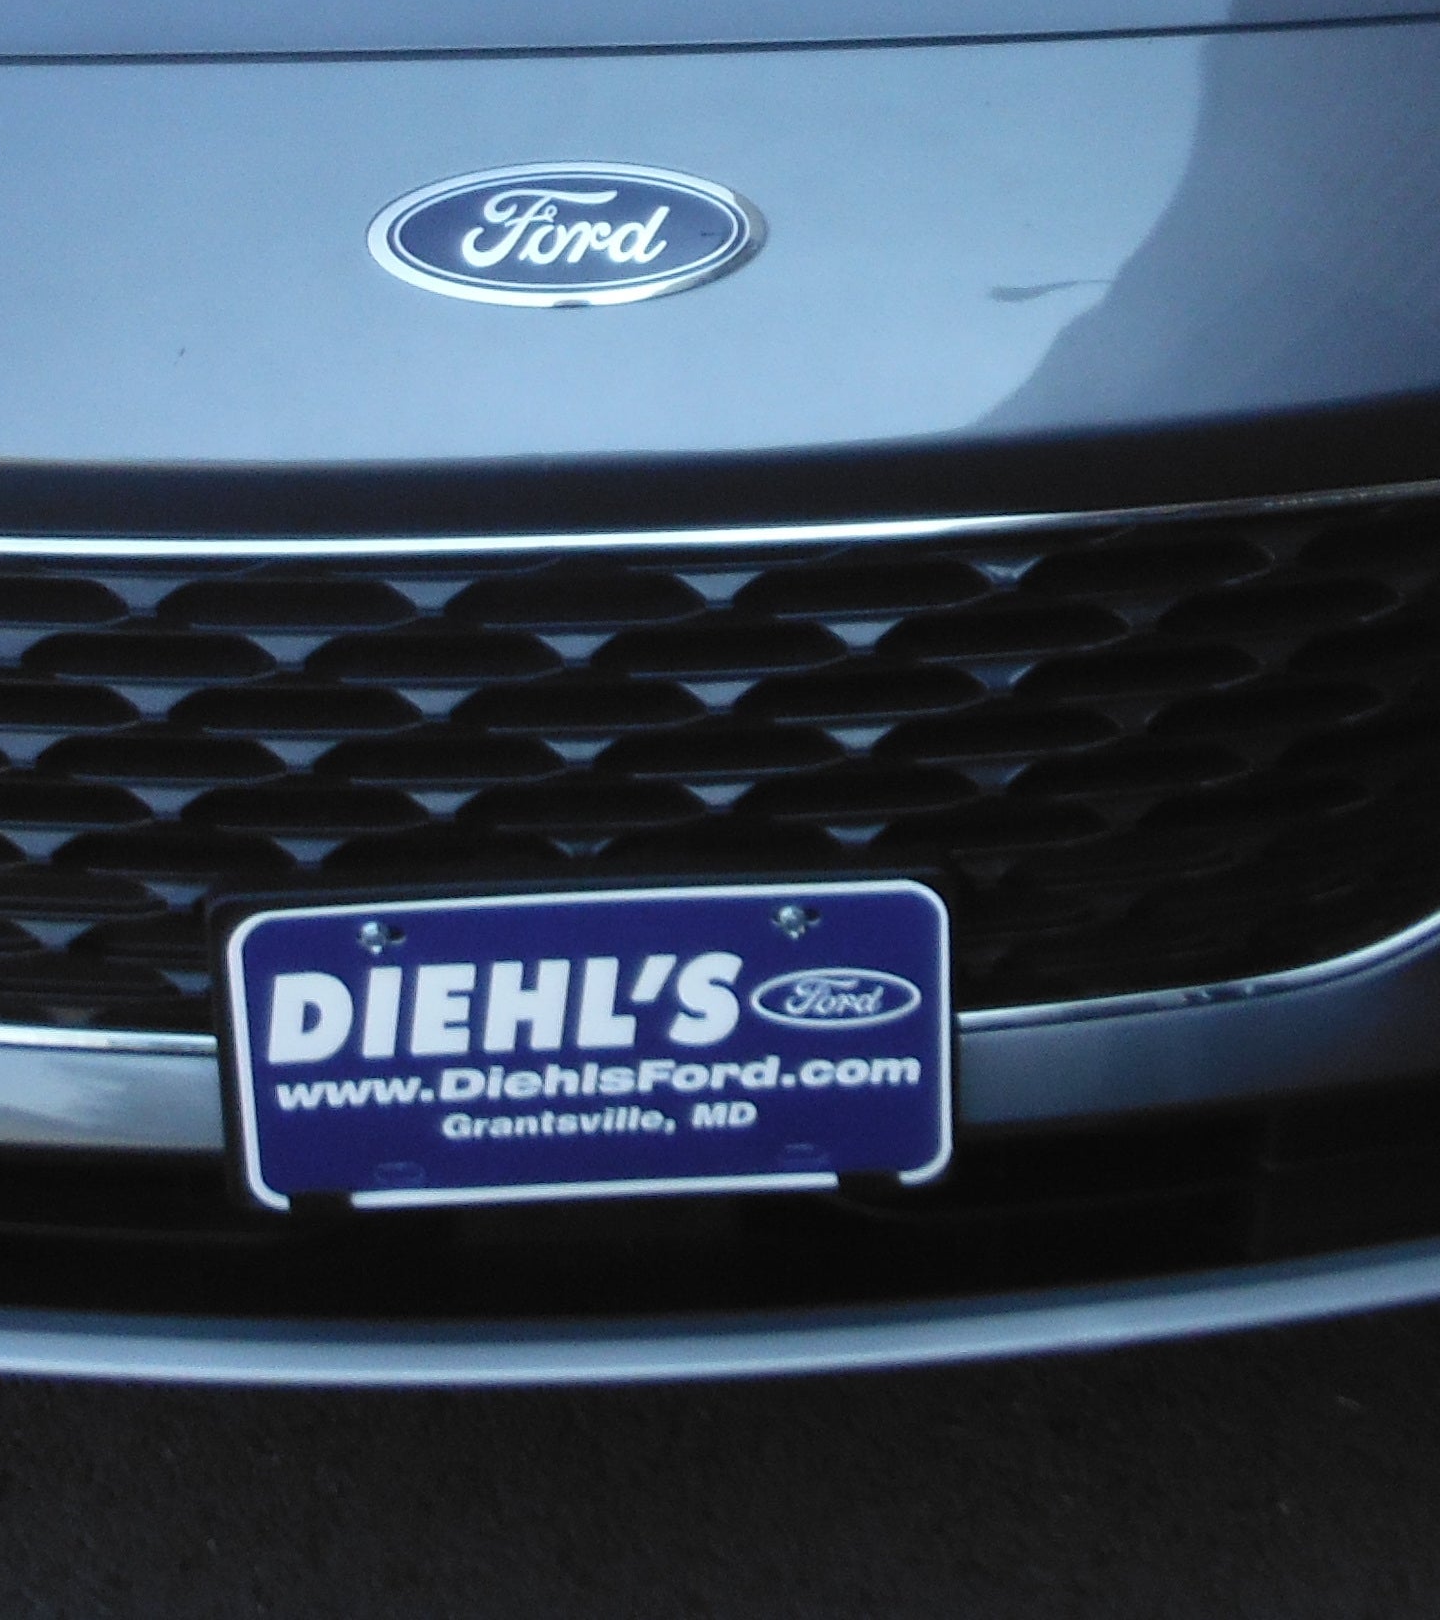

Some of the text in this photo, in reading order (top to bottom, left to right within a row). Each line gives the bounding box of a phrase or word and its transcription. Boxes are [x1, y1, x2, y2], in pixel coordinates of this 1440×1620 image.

[461, 188, 671, 267] Ford
[267, 951, 885, 1065] DIEHL'S Ford
[275, 1056, 922, 1112] www.DiehlsFord.com
[441, 1102, 758, 1140] Grantsville, MD
